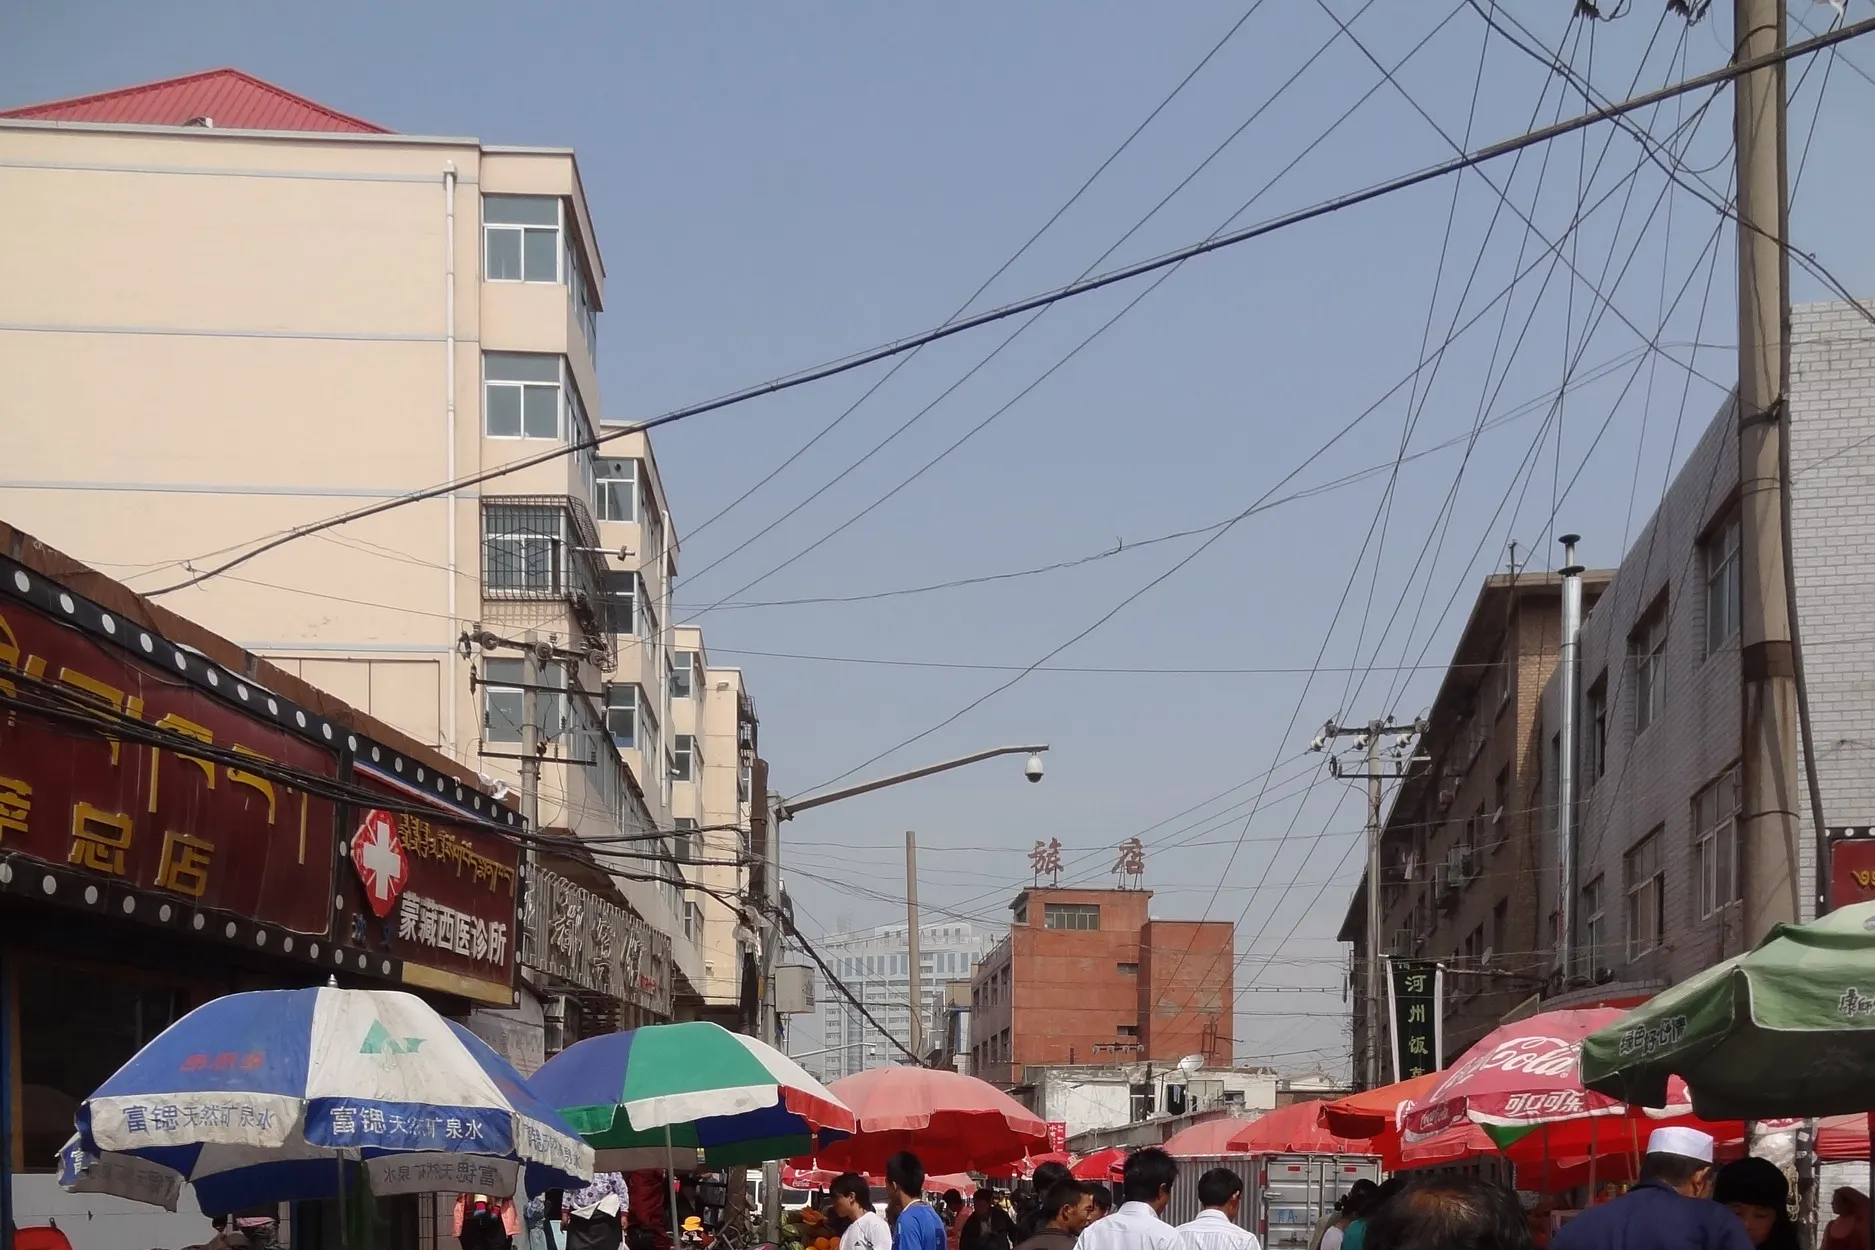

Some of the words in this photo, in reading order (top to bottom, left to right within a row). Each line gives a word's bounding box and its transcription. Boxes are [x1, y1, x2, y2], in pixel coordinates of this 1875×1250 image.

[399, 891, 507, 967] 蒙藏西医诊所
[123, 1104, 275, 1134] 富锶天然矿泉水
[1505, 1089, 1584, 1117] 可口可乐
[329, 1105, 484, 1140] 富锶天然矿泉水
